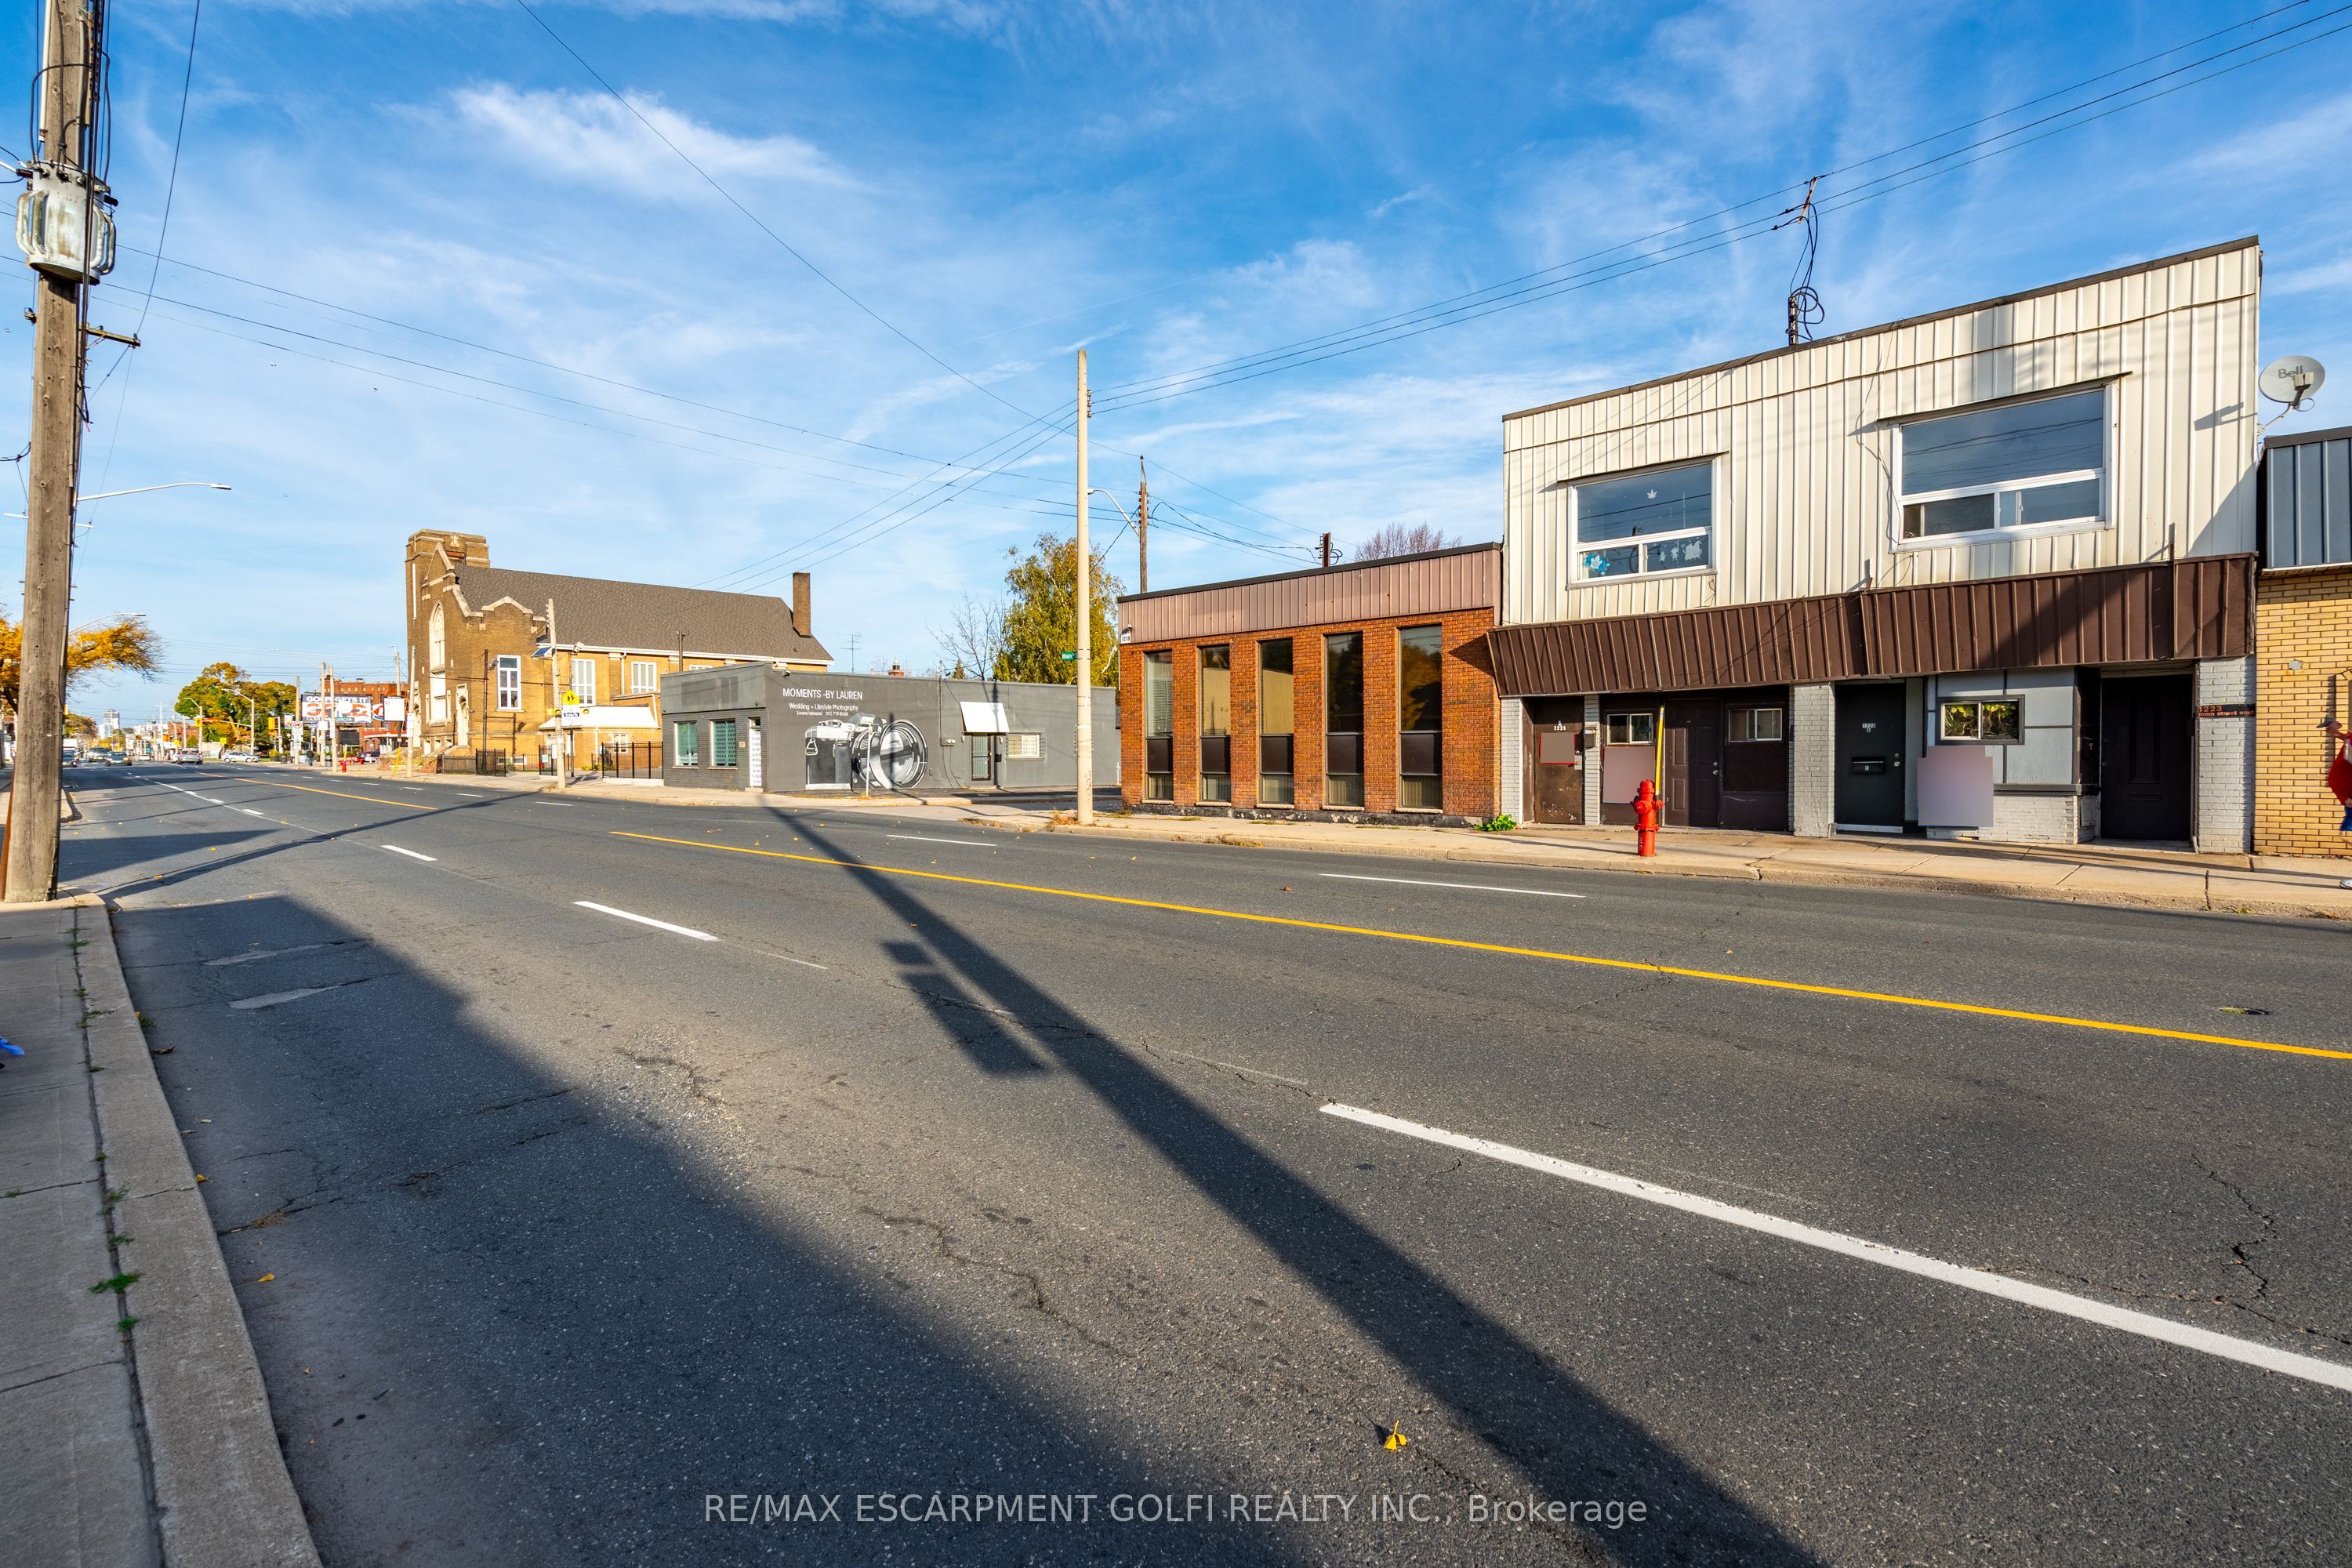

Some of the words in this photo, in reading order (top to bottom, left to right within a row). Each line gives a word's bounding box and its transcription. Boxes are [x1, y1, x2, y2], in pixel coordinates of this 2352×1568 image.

[782, 688, 821, 699] MOMENTS
[836, 691, 863, 700] LAUREN
[789, 702, 810, 711] Wedding
